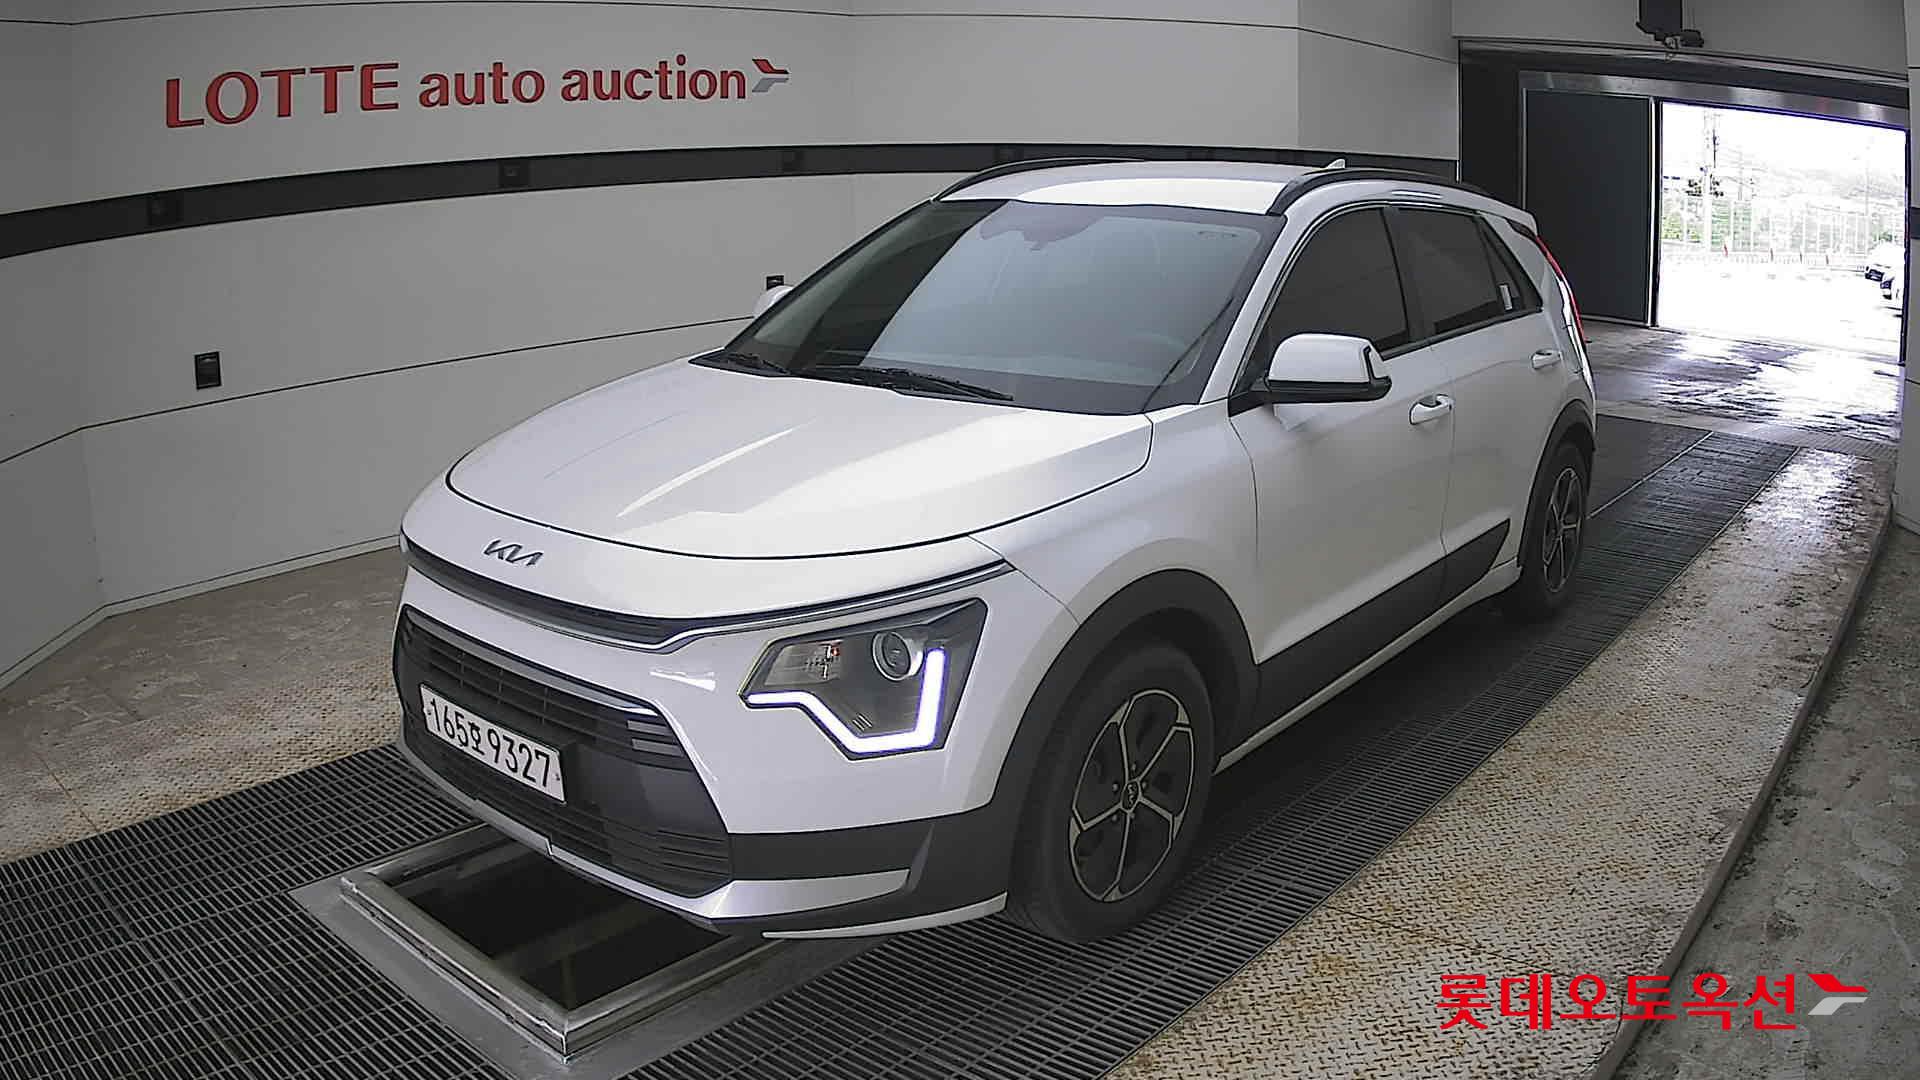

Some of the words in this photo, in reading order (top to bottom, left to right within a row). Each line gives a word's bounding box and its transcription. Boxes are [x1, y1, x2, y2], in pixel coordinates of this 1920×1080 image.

[166, 62, 399, 128] LOTTE
[418, 62, 546, 108] auto
[560, 54, 746, 101] auction
